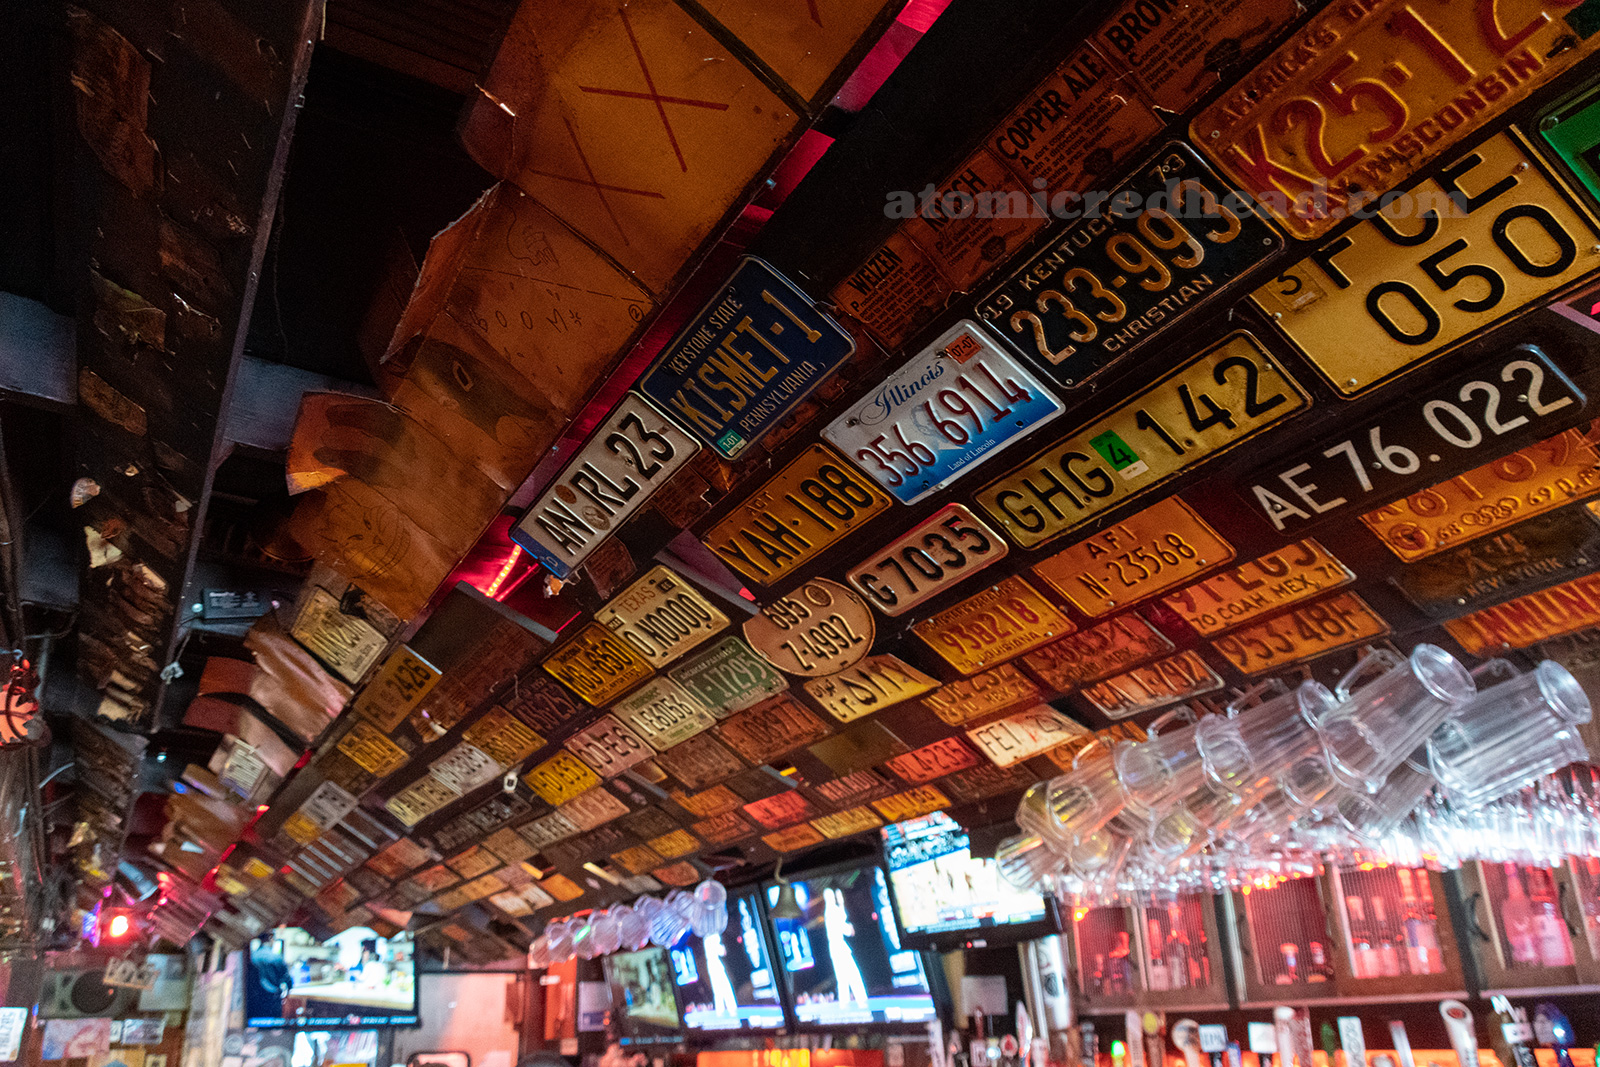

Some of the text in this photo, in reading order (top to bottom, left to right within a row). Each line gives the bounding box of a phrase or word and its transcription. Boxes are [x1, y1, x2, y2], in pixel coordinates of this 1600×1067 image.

[996, 53, 1107, 160] COPPER ALE
[1050, 152, 1065, 167] and
[1085, 101, 1123, 136] Traditional
[1358, 46, 1545, 184] WISCONSIN
[848, 246, 903, 297] WEIZEN
[1366, 203, 1577, 346] 050
[671, 294, 744, 377] KEYSTONE STATE
[1102, 272, 1214, 352] CHRISTIAN
[951, 335, 977, 358] 07-07
[741, 360, 819, 432] PENNSYLVANIA
[858, 360, 1033, 487] 356 6914
[859, 360, 946, 426] Illinois
[604, 410, 678, 480] 23
[722, 434, 739, 449] 1-01
[947, 457, 964, 471] Land
[970, 438, 996, 460] Lincoln
[1252, 462, 1349, 530] AE
[618, 585, 656, 614] TEXAS
[1077, 531, 1199, 600] N-23568
[979, 631, 1041, 665] LOUISIANA
